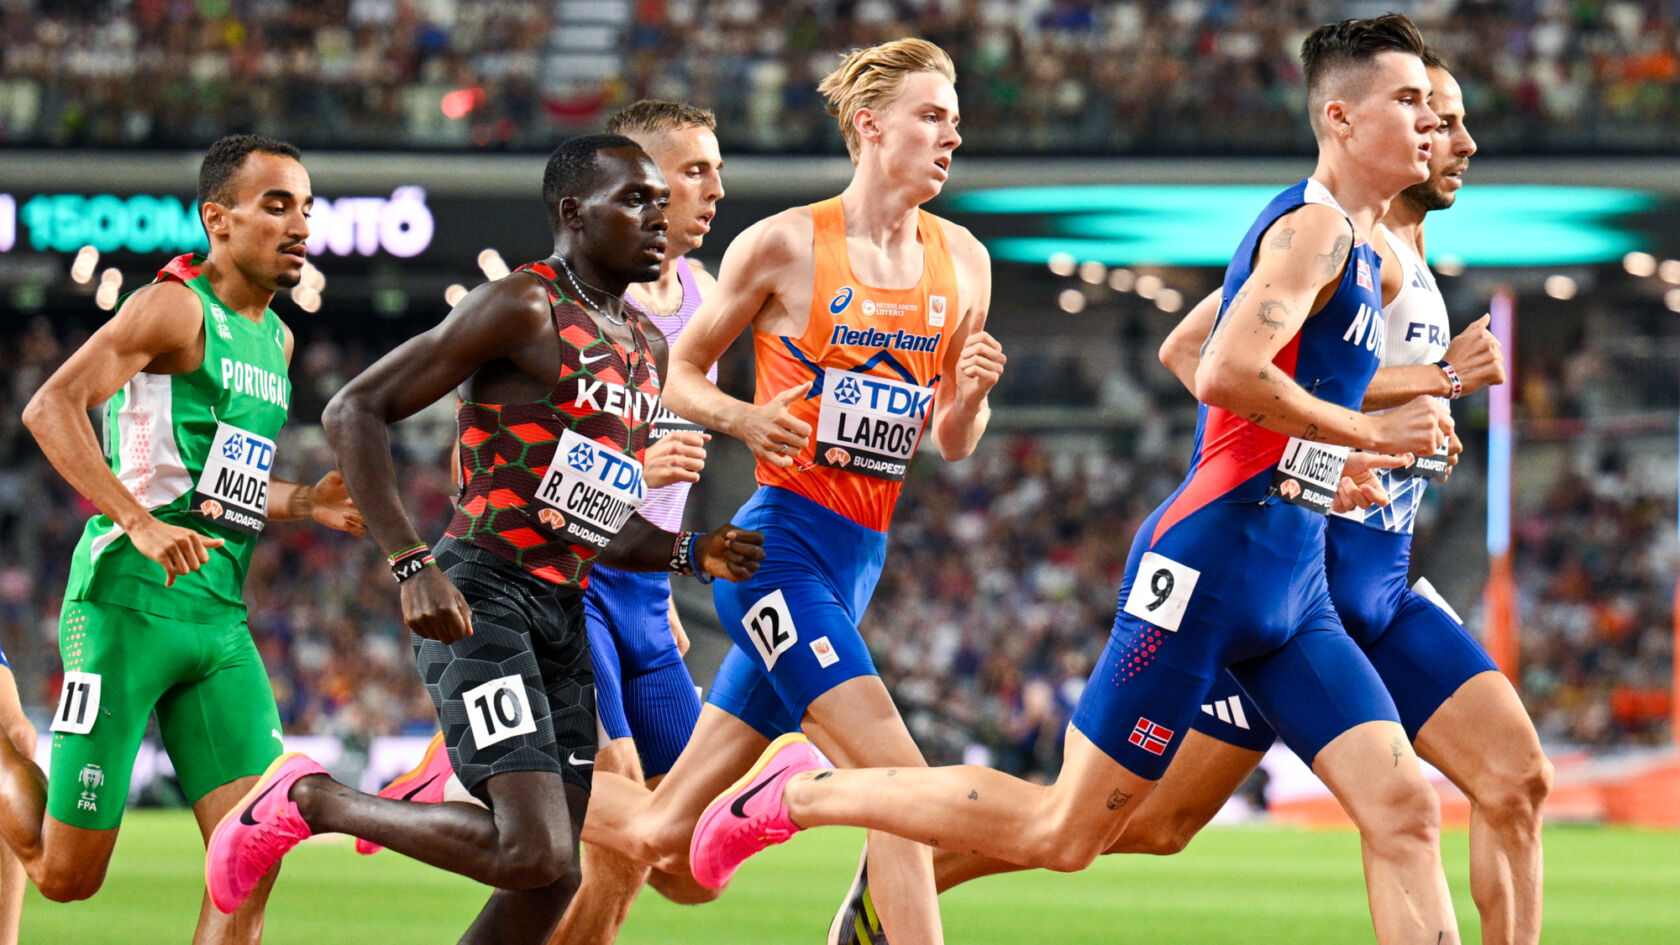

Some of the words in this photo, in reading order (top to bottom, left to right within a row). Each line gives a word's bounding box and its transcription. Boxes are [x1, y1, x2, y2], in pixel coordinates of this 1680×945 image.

[830, 325, 942, 353] Nederland
[221, 357, 288, 410] PORTUGAL
[862, 380, 932, 419] TDK
[837, 412, 916, 455] LAROS
[598, 450, 643, 499] TDK
[1285, 442, 1302, 471] J.
[543, 470, 561, 503] R.
[1145, 568, 1175, 612] 9
[751, 606, 790, 656] 12
[61, 681, 91, 725] 11
[474, 687, 523, 736] 10
[77, 799, 97, 812] FPA
